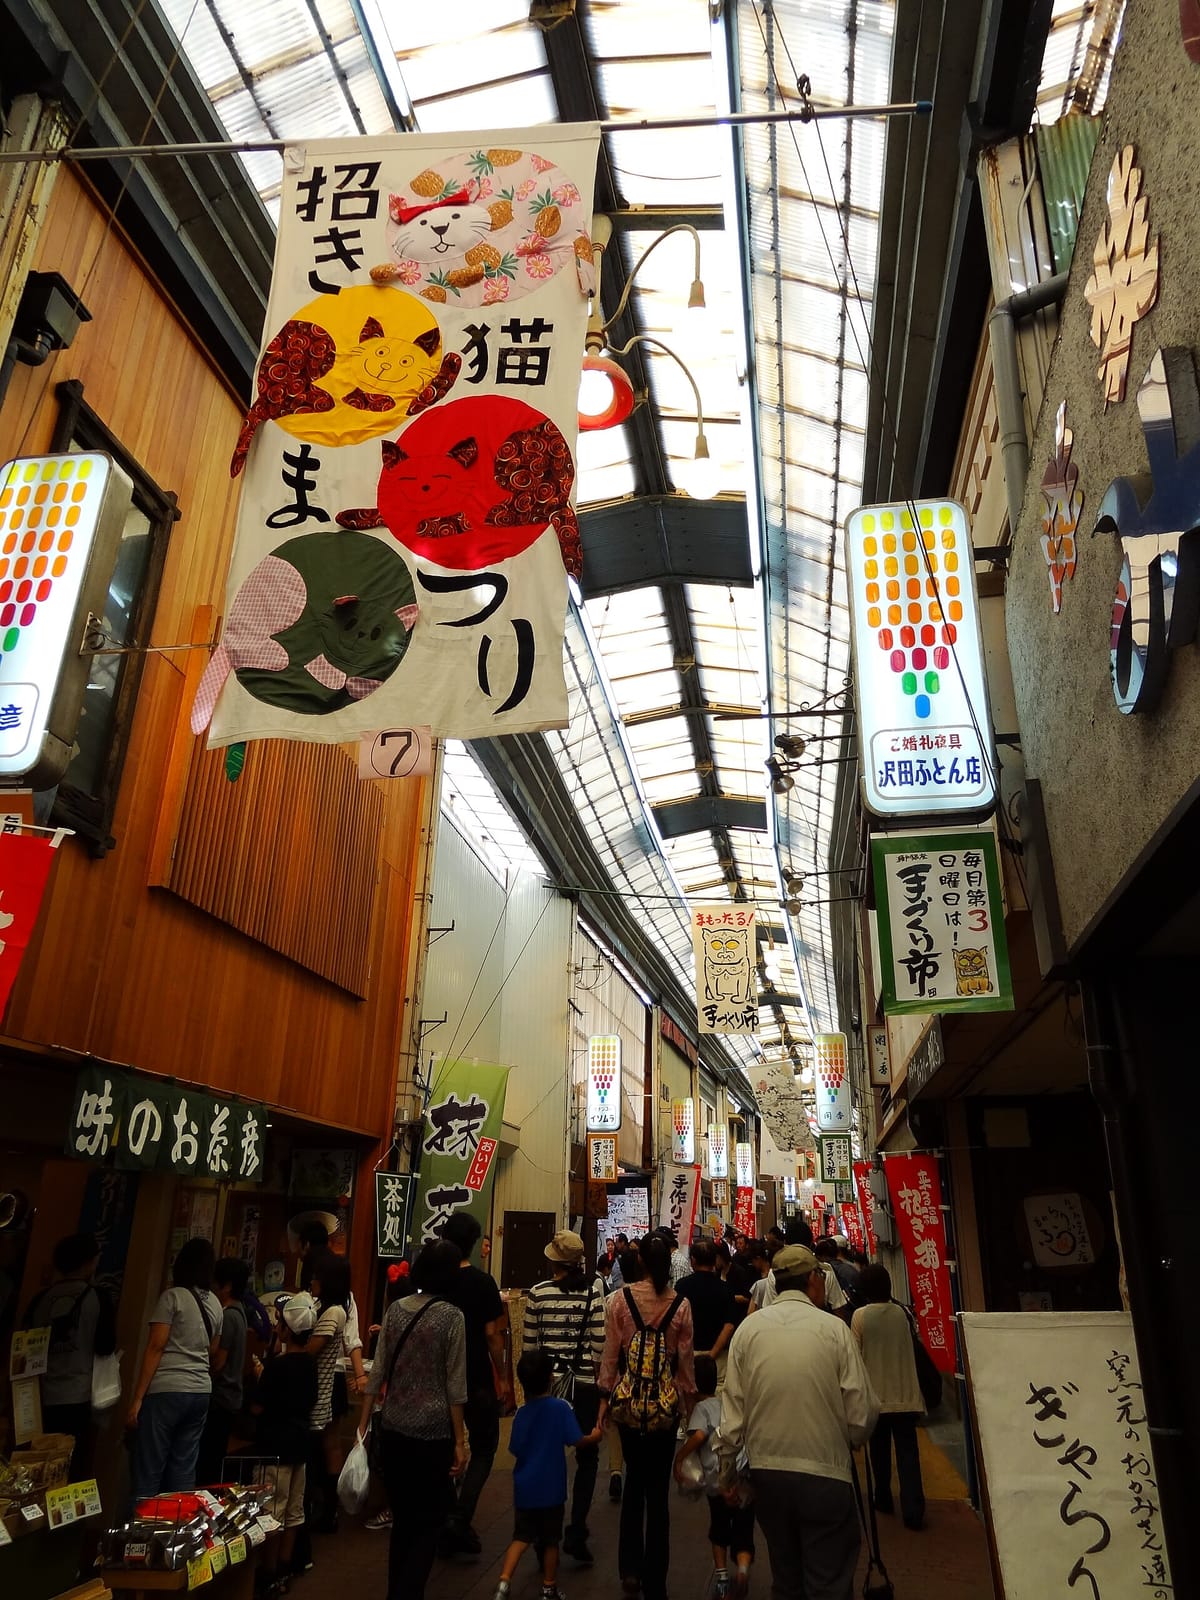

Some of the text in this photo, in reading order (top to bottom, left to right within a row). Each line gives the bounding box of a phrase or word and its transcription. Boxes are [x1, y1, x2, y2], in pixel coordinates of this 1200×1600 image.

[295, 161, 382, 295] 招き
[462, 317, 555, 386] 猫
[266, 445, 331, 530] ま
[416, 571, 537, 717] つり
[878, 755, 981, 788] 沢田ふとん店
[890, 733, 962, 752] ご婚礼夜具
[962, 851, 989, 932] 毎月第3
[896, 863, 943, 997] 手づくり市
[702, 1004, 760, 1032] 手づくり市
[590, 1114, 615, 1123] イソムラ
[469, 1141, 494, 1187] おいしい
[383, 1177, 404, 1247] 茶処
[896, 1180, 941, 1270] 招き猫
